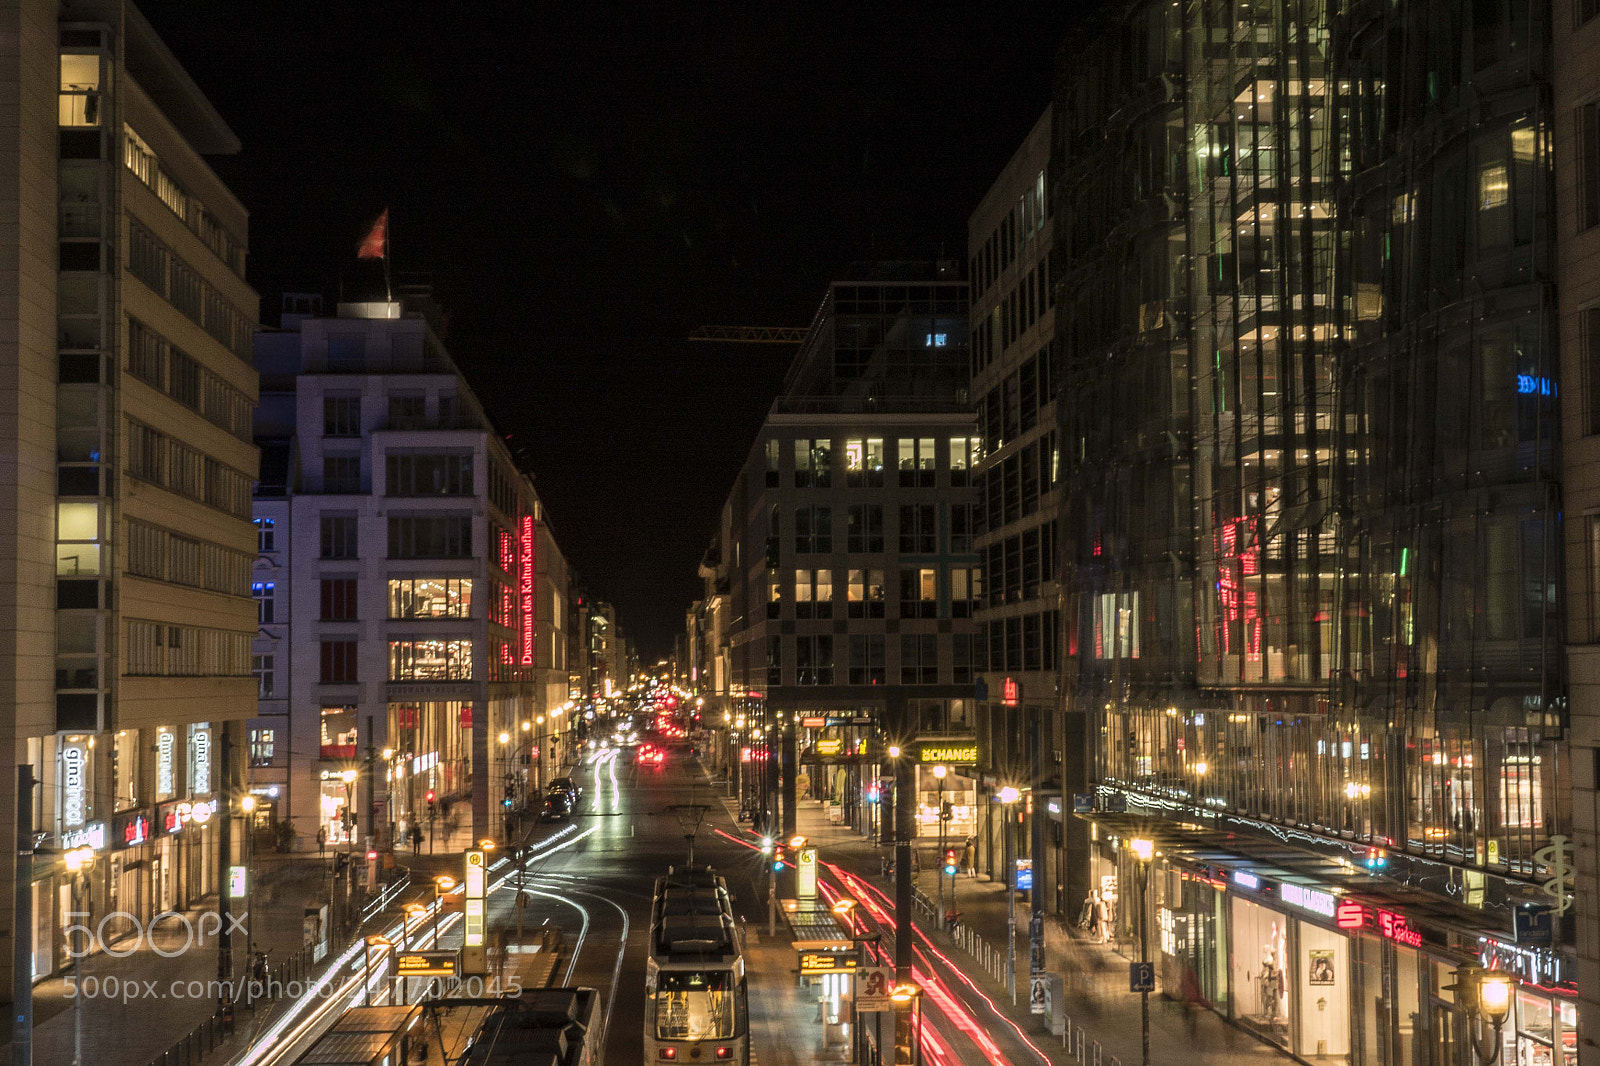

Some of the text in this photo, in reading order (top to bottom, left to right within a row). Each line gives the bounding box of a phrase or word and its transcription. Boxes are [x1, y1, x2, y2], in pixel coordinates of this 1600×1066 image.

[521, 516, 533, 665] Dussmann das KulturKaufhaus
[689, 974, 703, 986] 12
